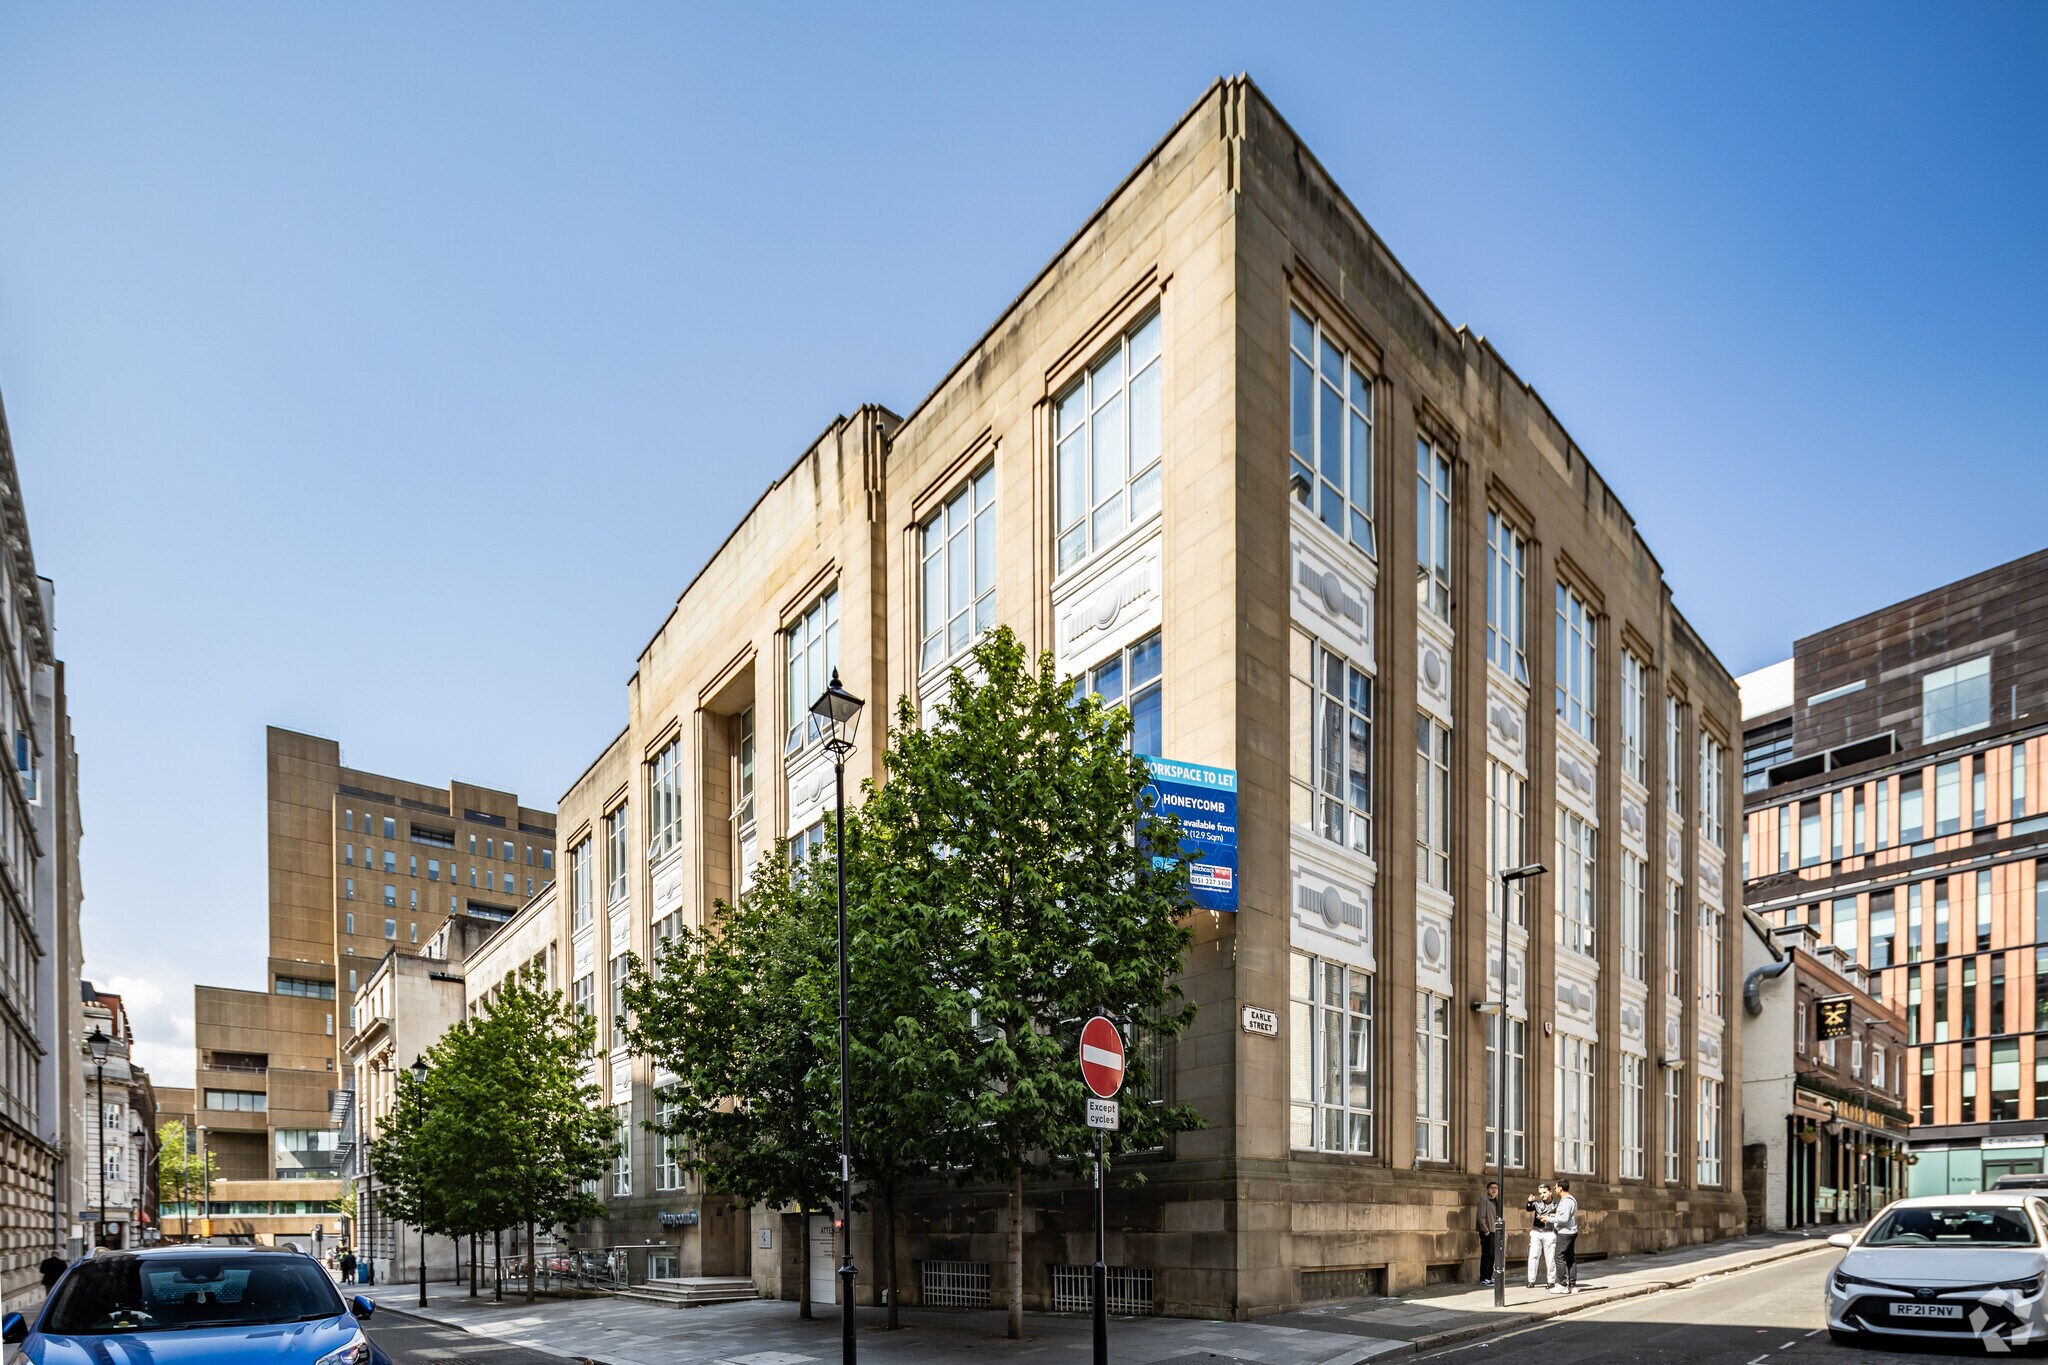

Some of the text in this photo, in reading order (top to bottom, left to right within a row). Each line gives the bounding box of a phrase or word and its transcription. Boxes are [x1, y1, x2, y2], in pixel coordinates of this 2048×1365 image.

[1203, 771, 1216, 784] TO
[1218, 773, 1234, 787] LET
[1163, 793, 1225, 813] HONEYCOMB
[1183, 819, 1216, 831] available
[1217, 822, 1235, 833] from
[1206, 832, 1224, 843] Sqm)
[1251, 1011, 1271, 1022] EARLE
[1249, 1020, 1272, 1031] STREET
[1090, 1102, 1115, 1113] Except
[1090, 1115, 1114, 1124] cycles
[1897, 1304, 1953, 1316] RF21 PNV
